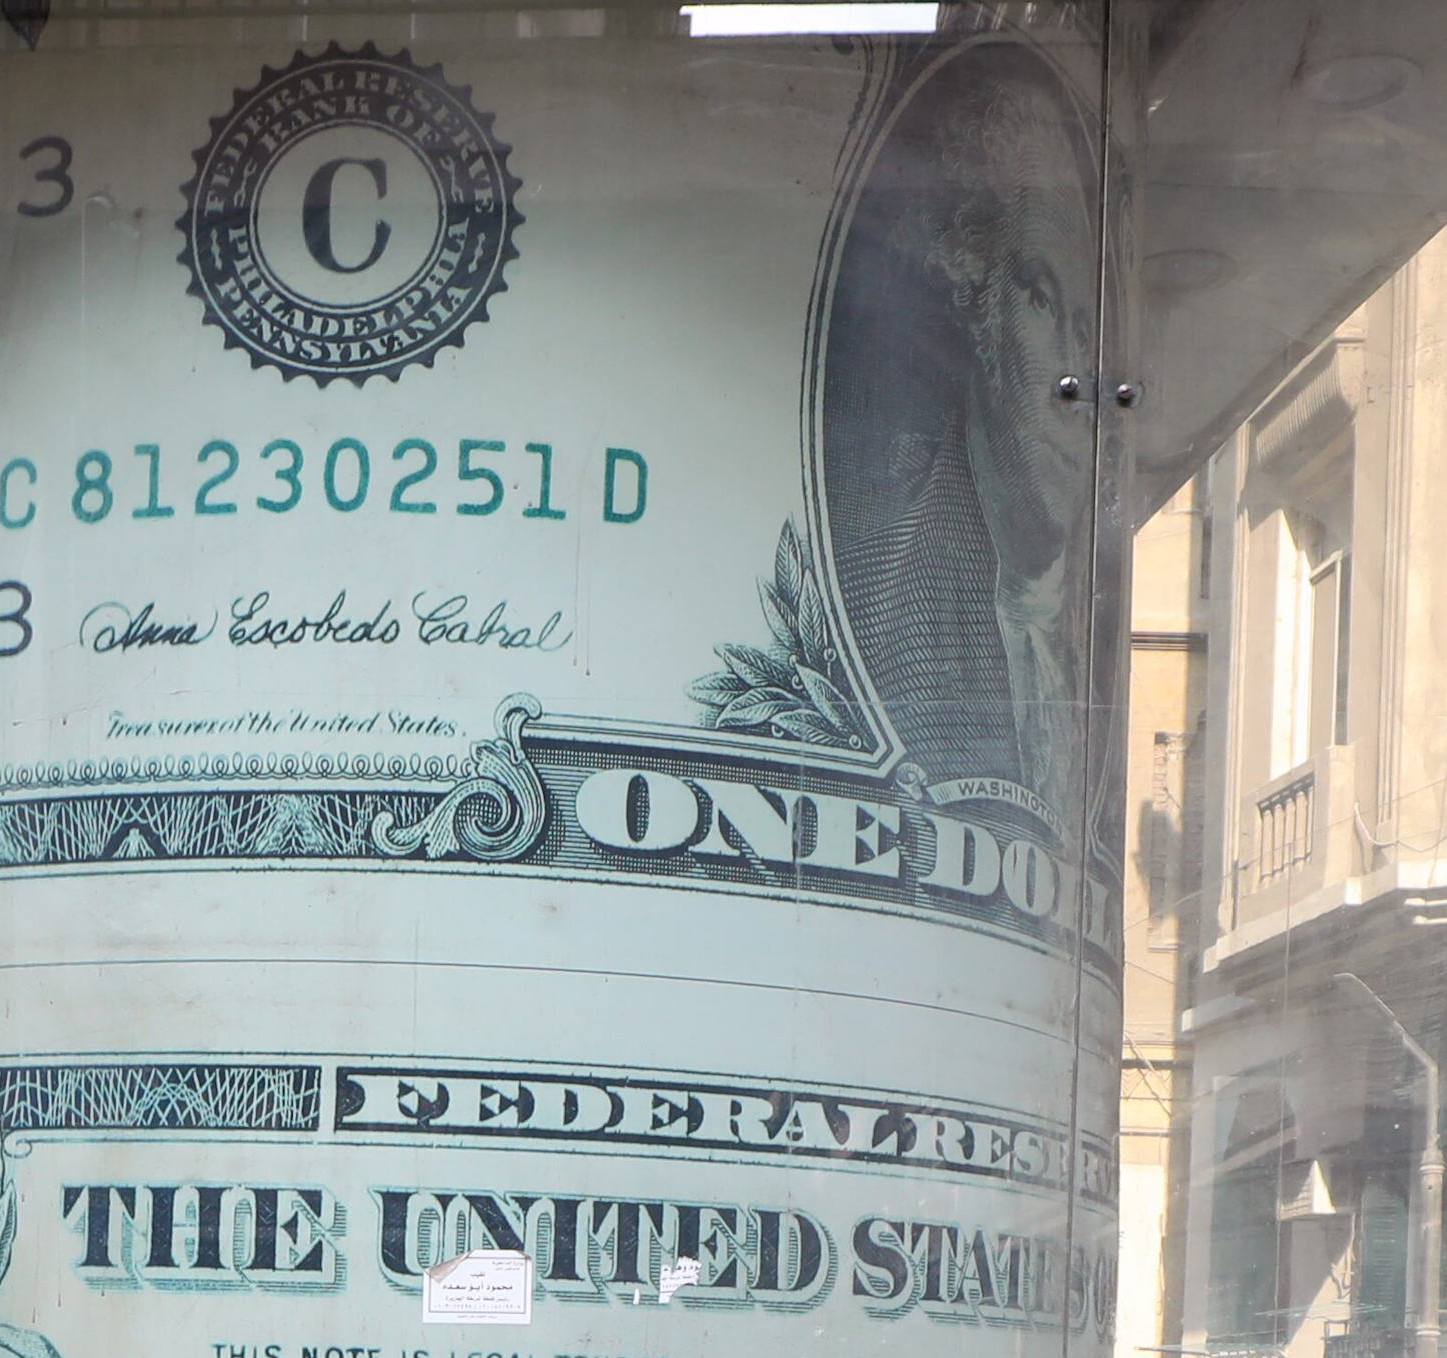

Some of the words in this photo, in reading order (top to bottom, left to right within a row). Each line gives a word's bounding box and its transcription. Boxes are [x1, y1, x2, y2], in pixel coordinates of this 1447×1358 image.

[206, 70, 345, 217] FEDERAL
[354, 70, 496, 214] RESERVE
[264, 95, 372, 153] BANK
[386, 104, 443, 146] OF
[17, 136, 76, 218] 3
[302, 157, 392, 274] C
[215, 278, 474, 363] PENNSYLVANIA
[228, 216, 471, 338] PHILADELPHIA
[71, 437, 567, 524] 81230251
[603, 447, 649, 524] D
[230, 590, 403, 652] Escobedo
[576, 767, 902, 878] ONE
[339, 1072, 899, 1155] FEDERAL
[61, 1183, 347, 1292] THE
[367, 1186, 839, 1314] UNITED
